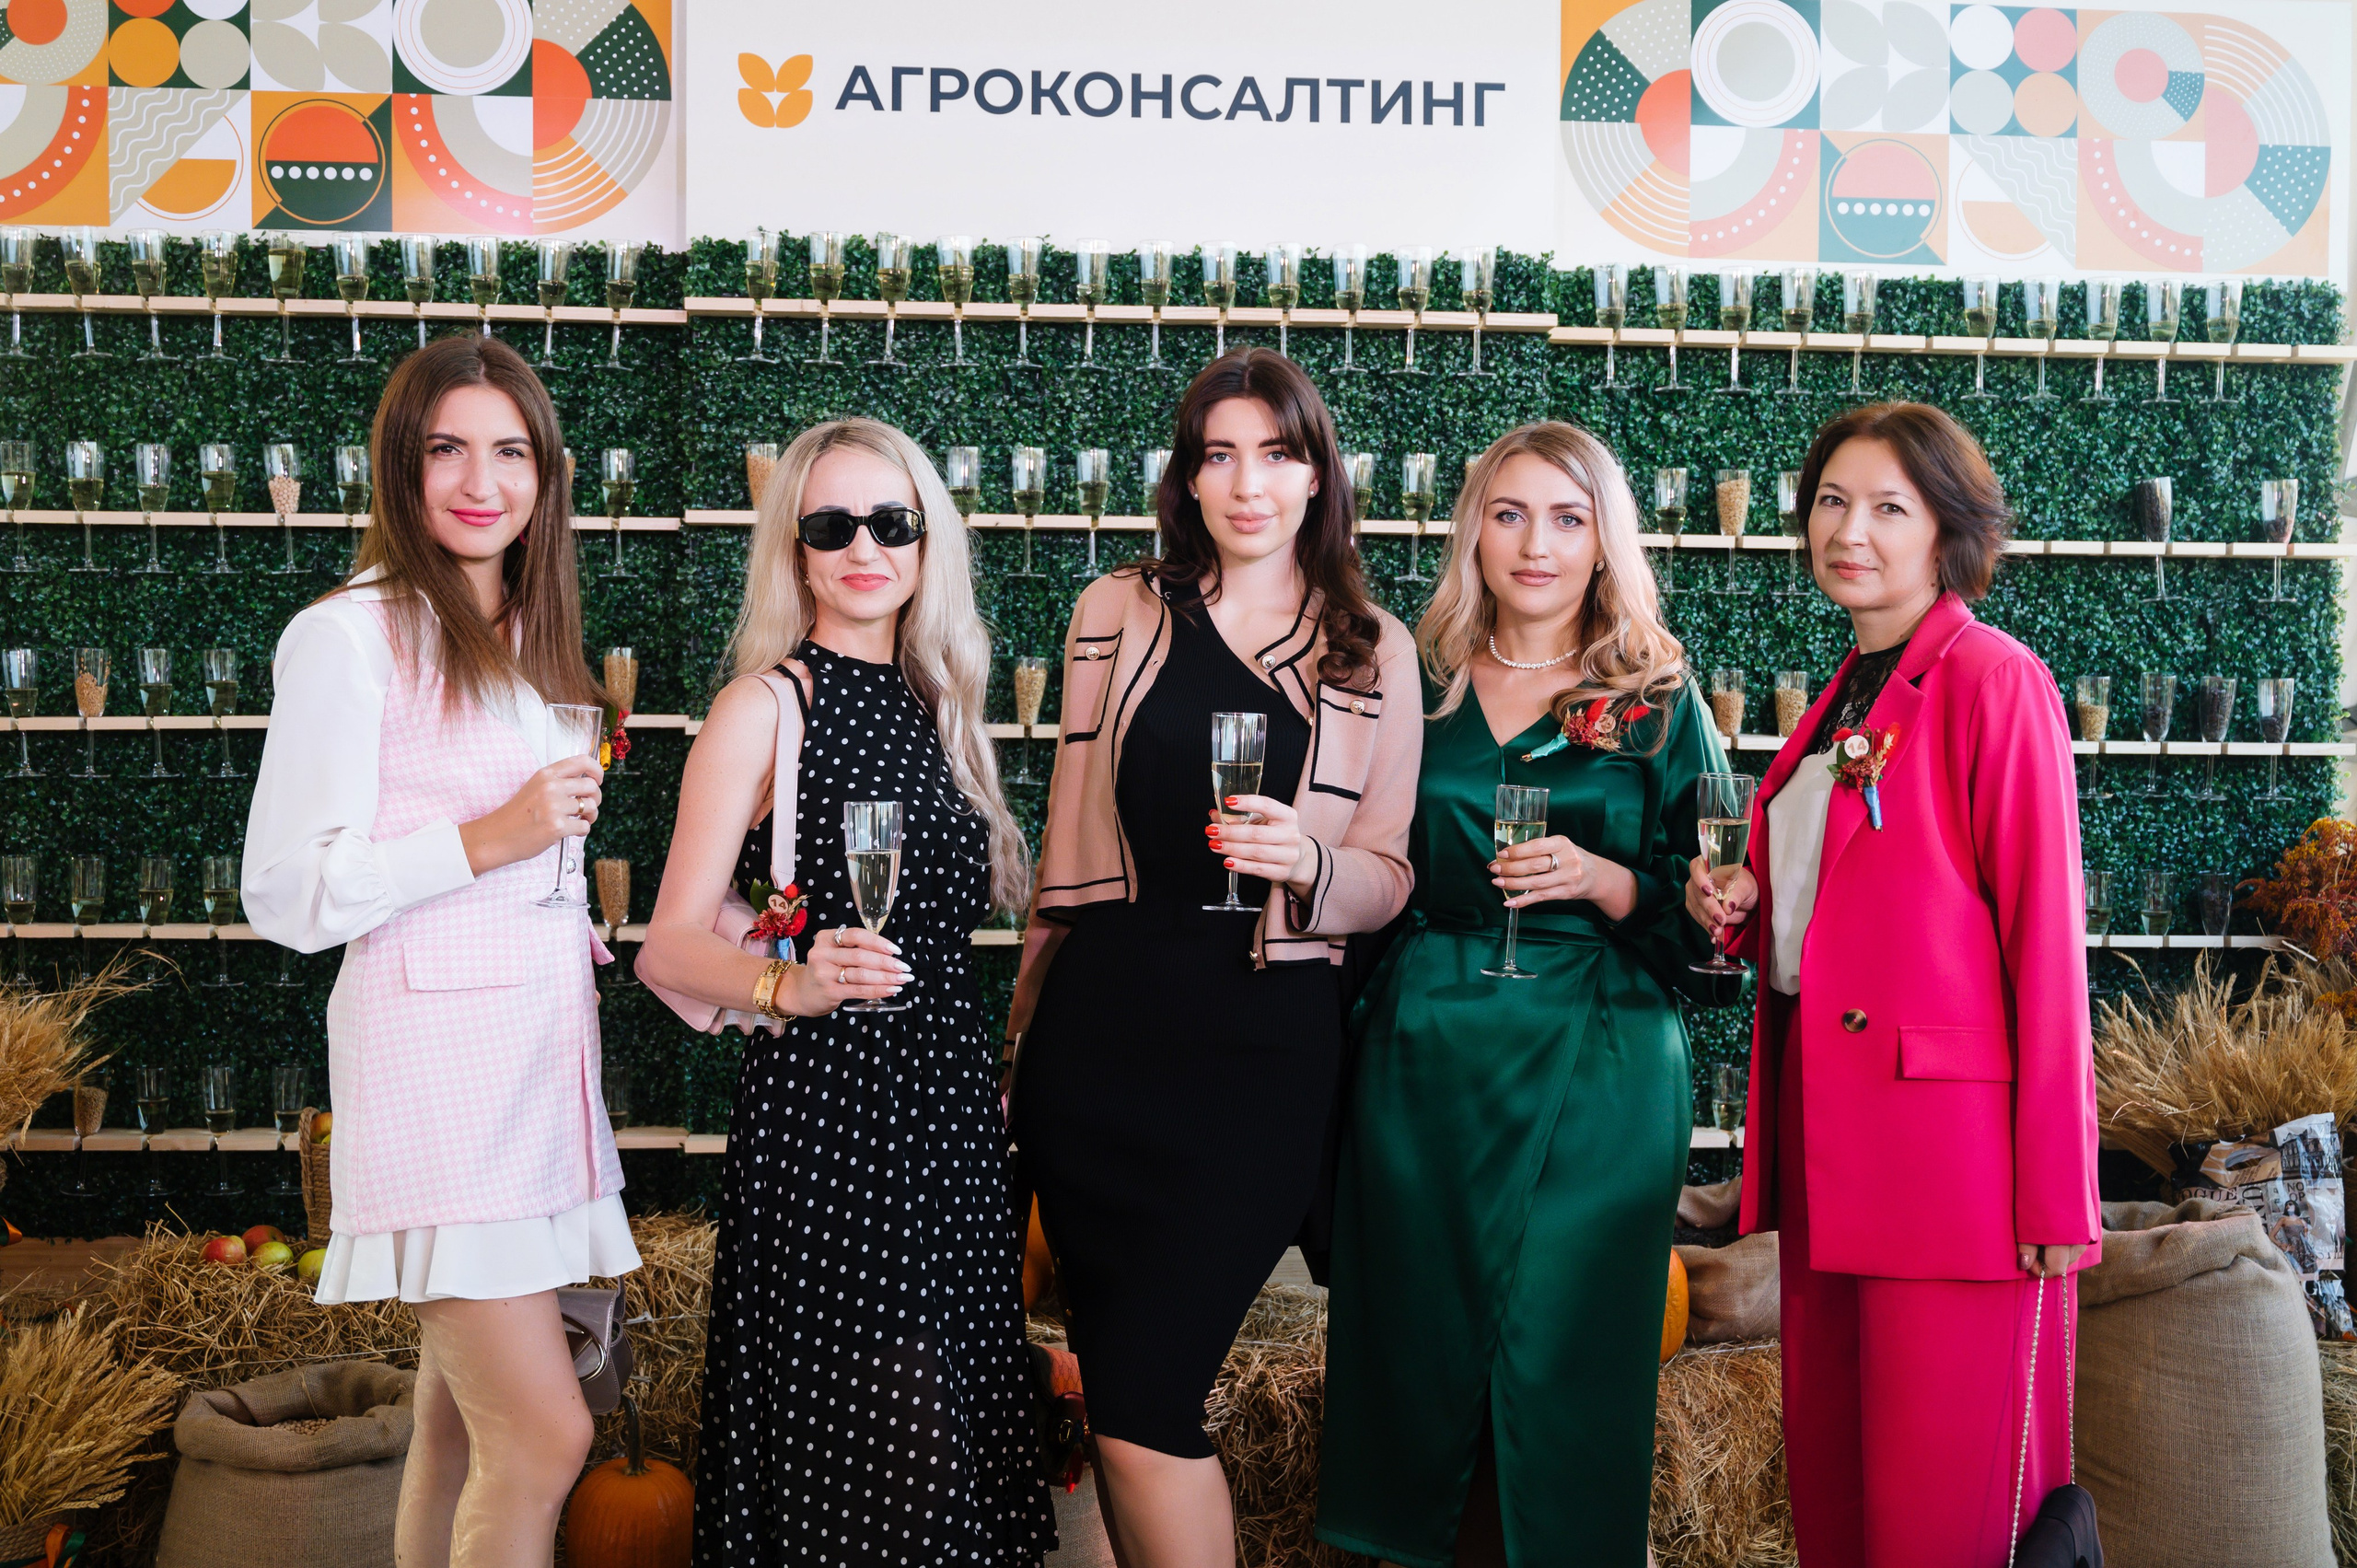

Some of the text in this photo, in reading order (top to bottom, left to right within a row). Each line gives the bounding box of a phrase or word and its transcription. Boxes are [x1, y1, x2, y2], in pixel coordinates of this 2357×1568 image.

[834, 64, 1505, 127] АГРОКОНСАЛТИНГ
[1847, 739, 1867, 754] 14
[771, 898, 787, 911] 14
